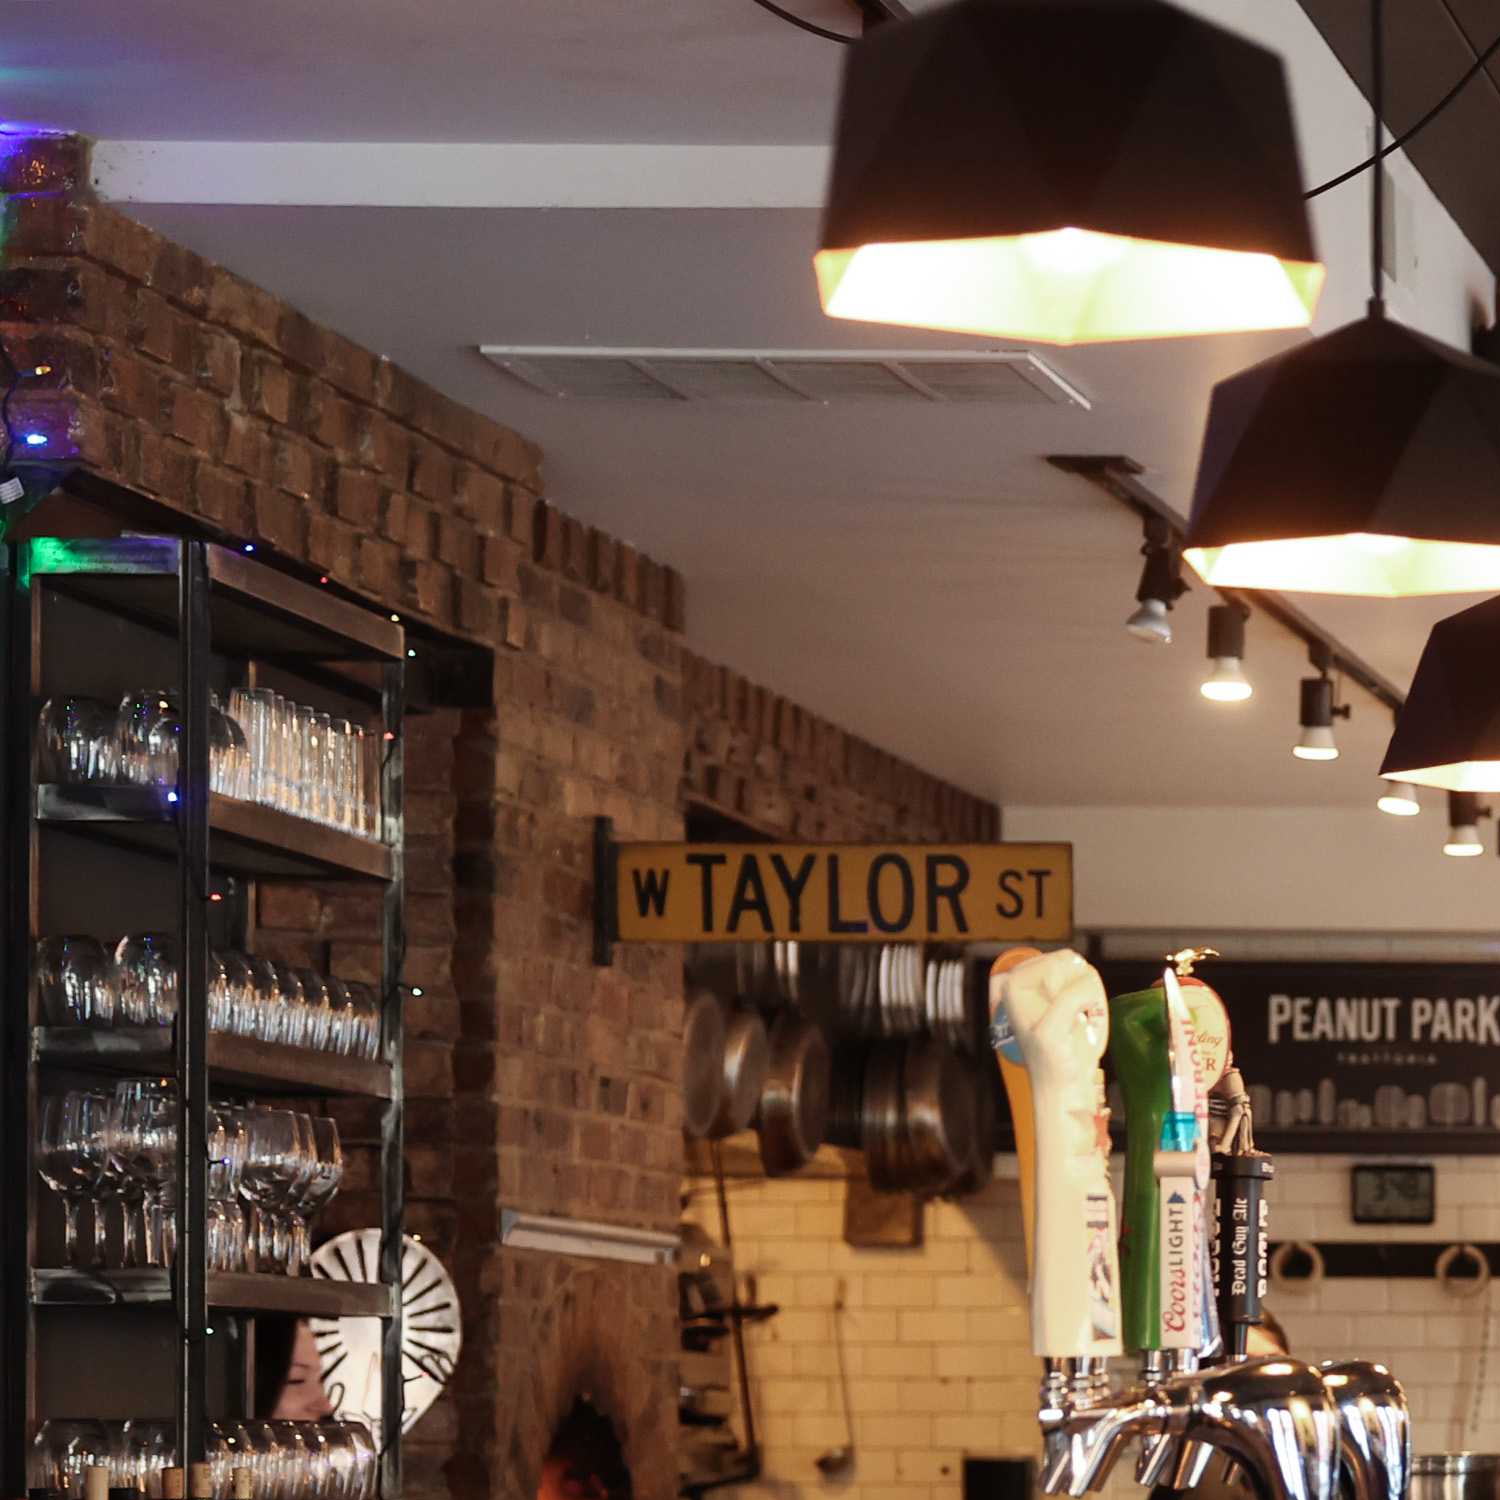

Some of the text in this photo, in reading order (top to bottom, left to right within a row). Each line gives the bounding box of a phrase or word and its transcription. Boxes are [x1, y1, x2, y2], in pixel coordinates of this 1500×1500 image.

[632, 853, 1052, 933] W TAYLOR ST
[1268, 994, 1401, 1044] PEANUT
[1164, 1207, 1187, 1333] Coors LIGHT
[1231, 1197, 1250, 1296] Dead Guy Ale
